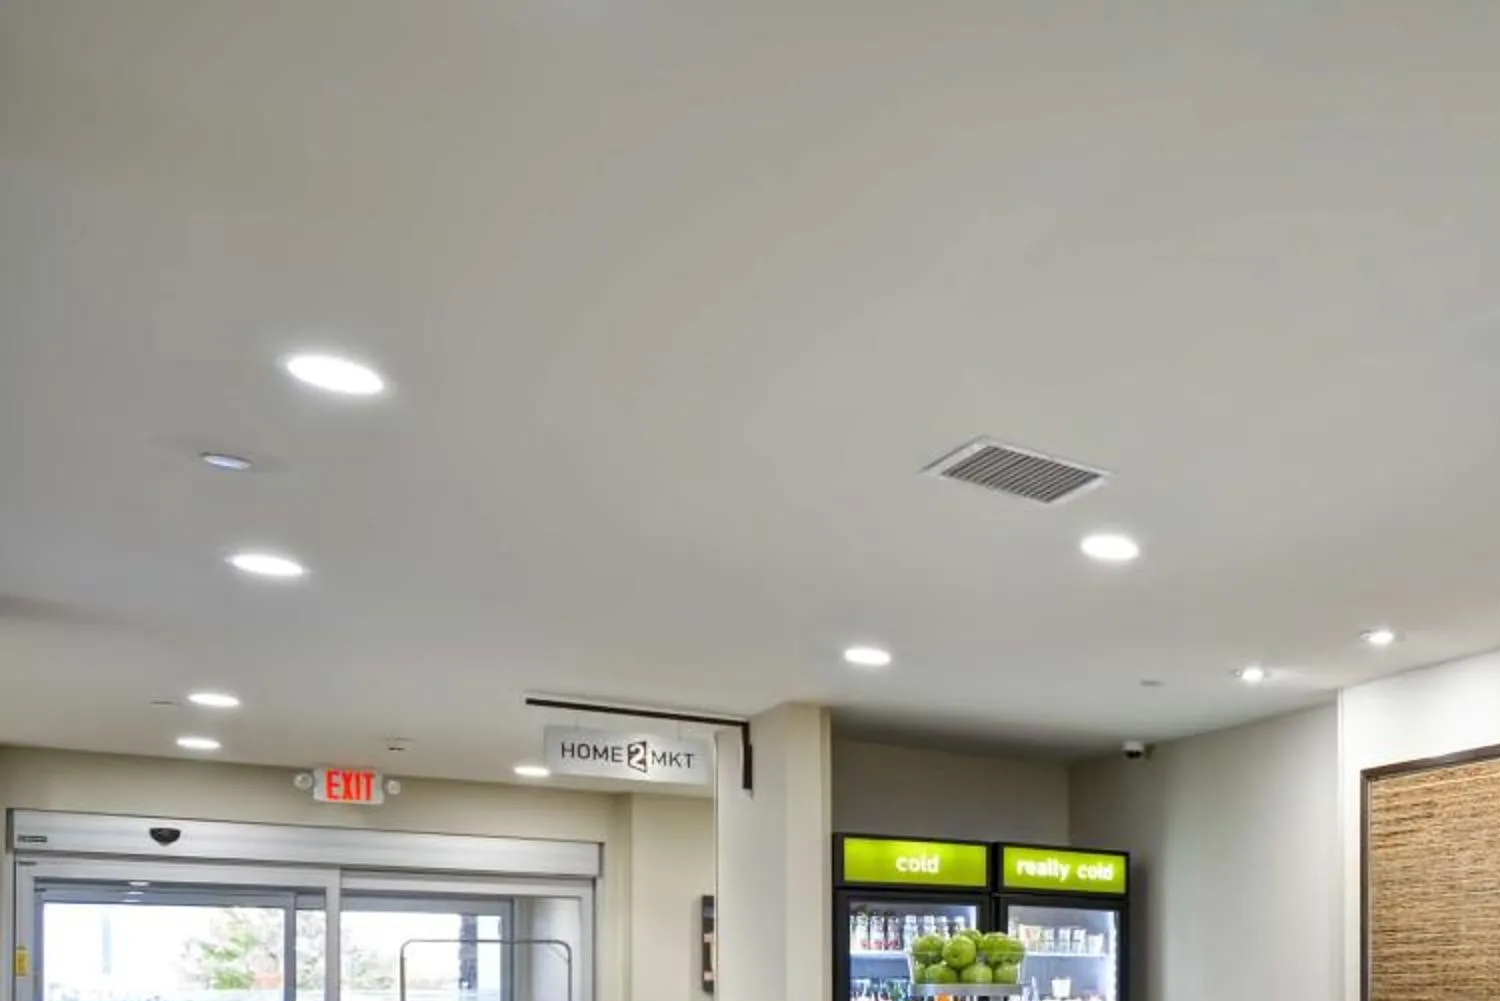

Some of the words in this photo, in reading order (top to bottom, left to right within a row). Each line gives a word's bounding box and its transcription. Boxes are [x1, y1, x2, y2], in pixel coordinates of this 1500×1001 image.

[325, 769, 375, 801] EXIT
[896, 855, 939, 874] cold
[1017, 858, 1069, 881] really
[1076, 862, 1115, 881] cold
